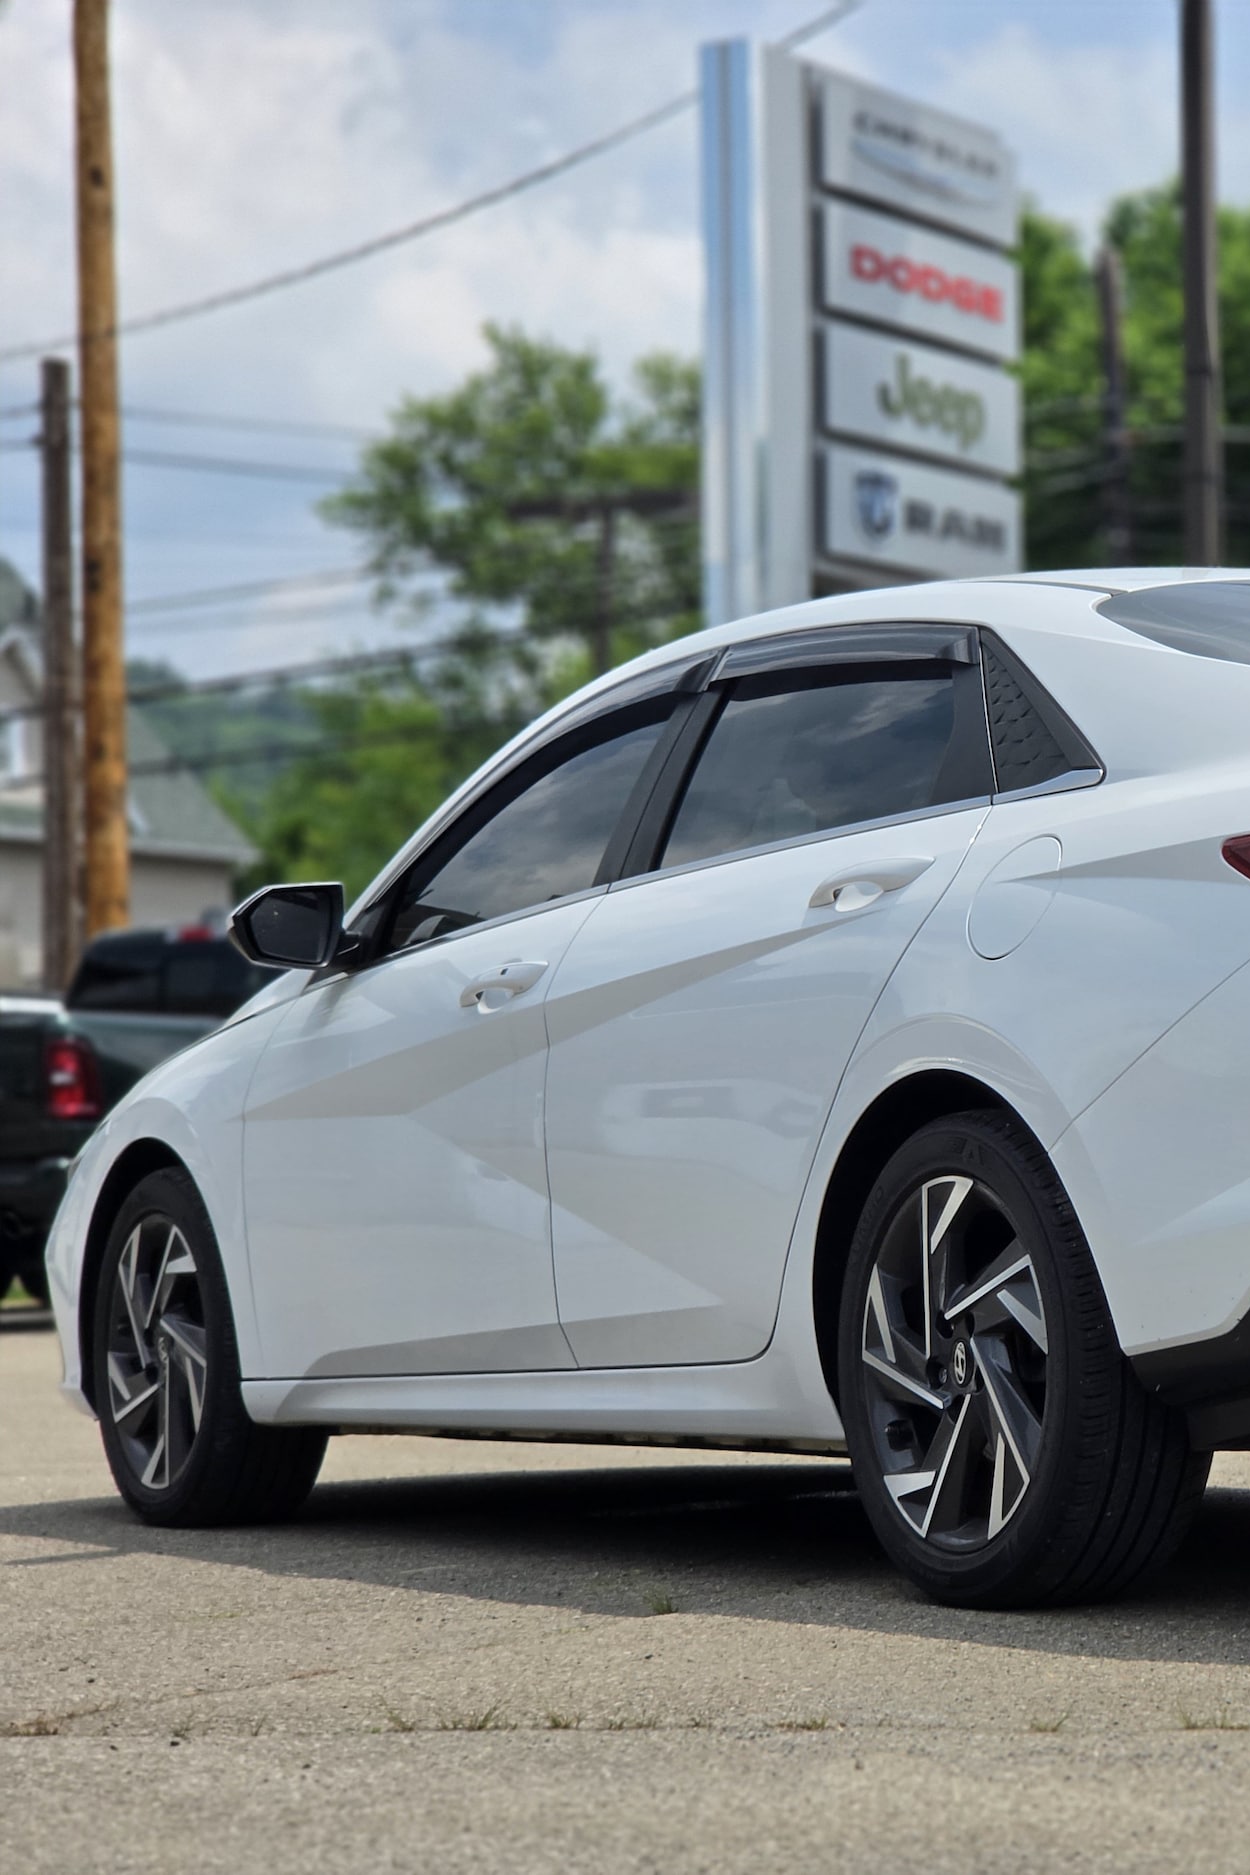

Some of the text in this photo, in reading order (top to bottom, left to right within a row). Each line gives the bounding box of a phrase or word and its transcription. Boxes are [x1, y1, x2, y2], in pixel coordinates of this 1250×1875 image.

[851, 245, 1004, 323] DODGE
[875, 352, 986, 450] Jeep
[903, 498, 1006, 555] RAM
